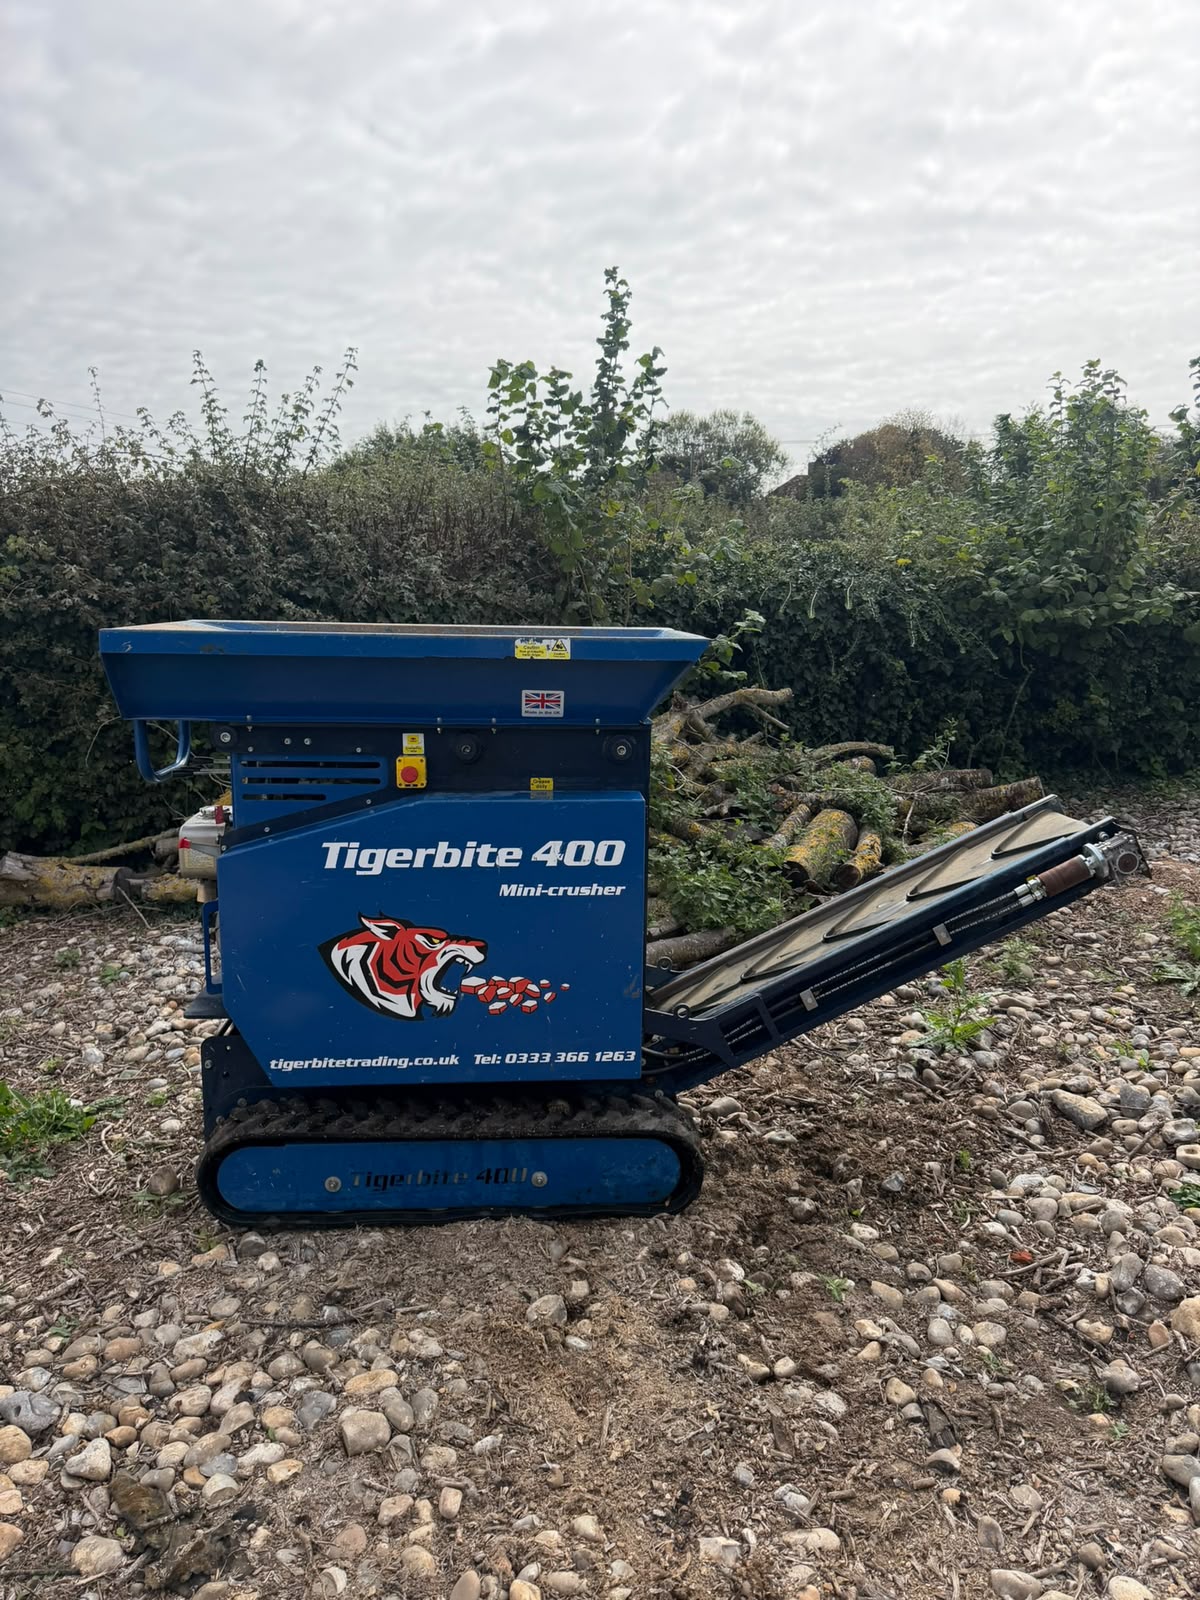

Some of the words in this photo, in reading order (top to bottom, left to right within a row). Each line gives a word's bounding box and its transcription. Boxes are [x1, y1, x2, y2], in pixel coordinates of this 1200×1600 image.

[322, 841, 523, 875] Tigerbite
[531, 840, 626, 867] 400
[499, 883, 626, 897] Mini-crusher
[269, 1054, 460, 1072] tigerbitetrading.co.uk
[474, 1054, 502, 1065] Tel:
[505, 1052, 551, 1064] 0333
[554, 1051, 590, 1063] 366
[595, 1050, 636, 1062] 1263
[351, 1168, 468, 1191] Tigerbite
